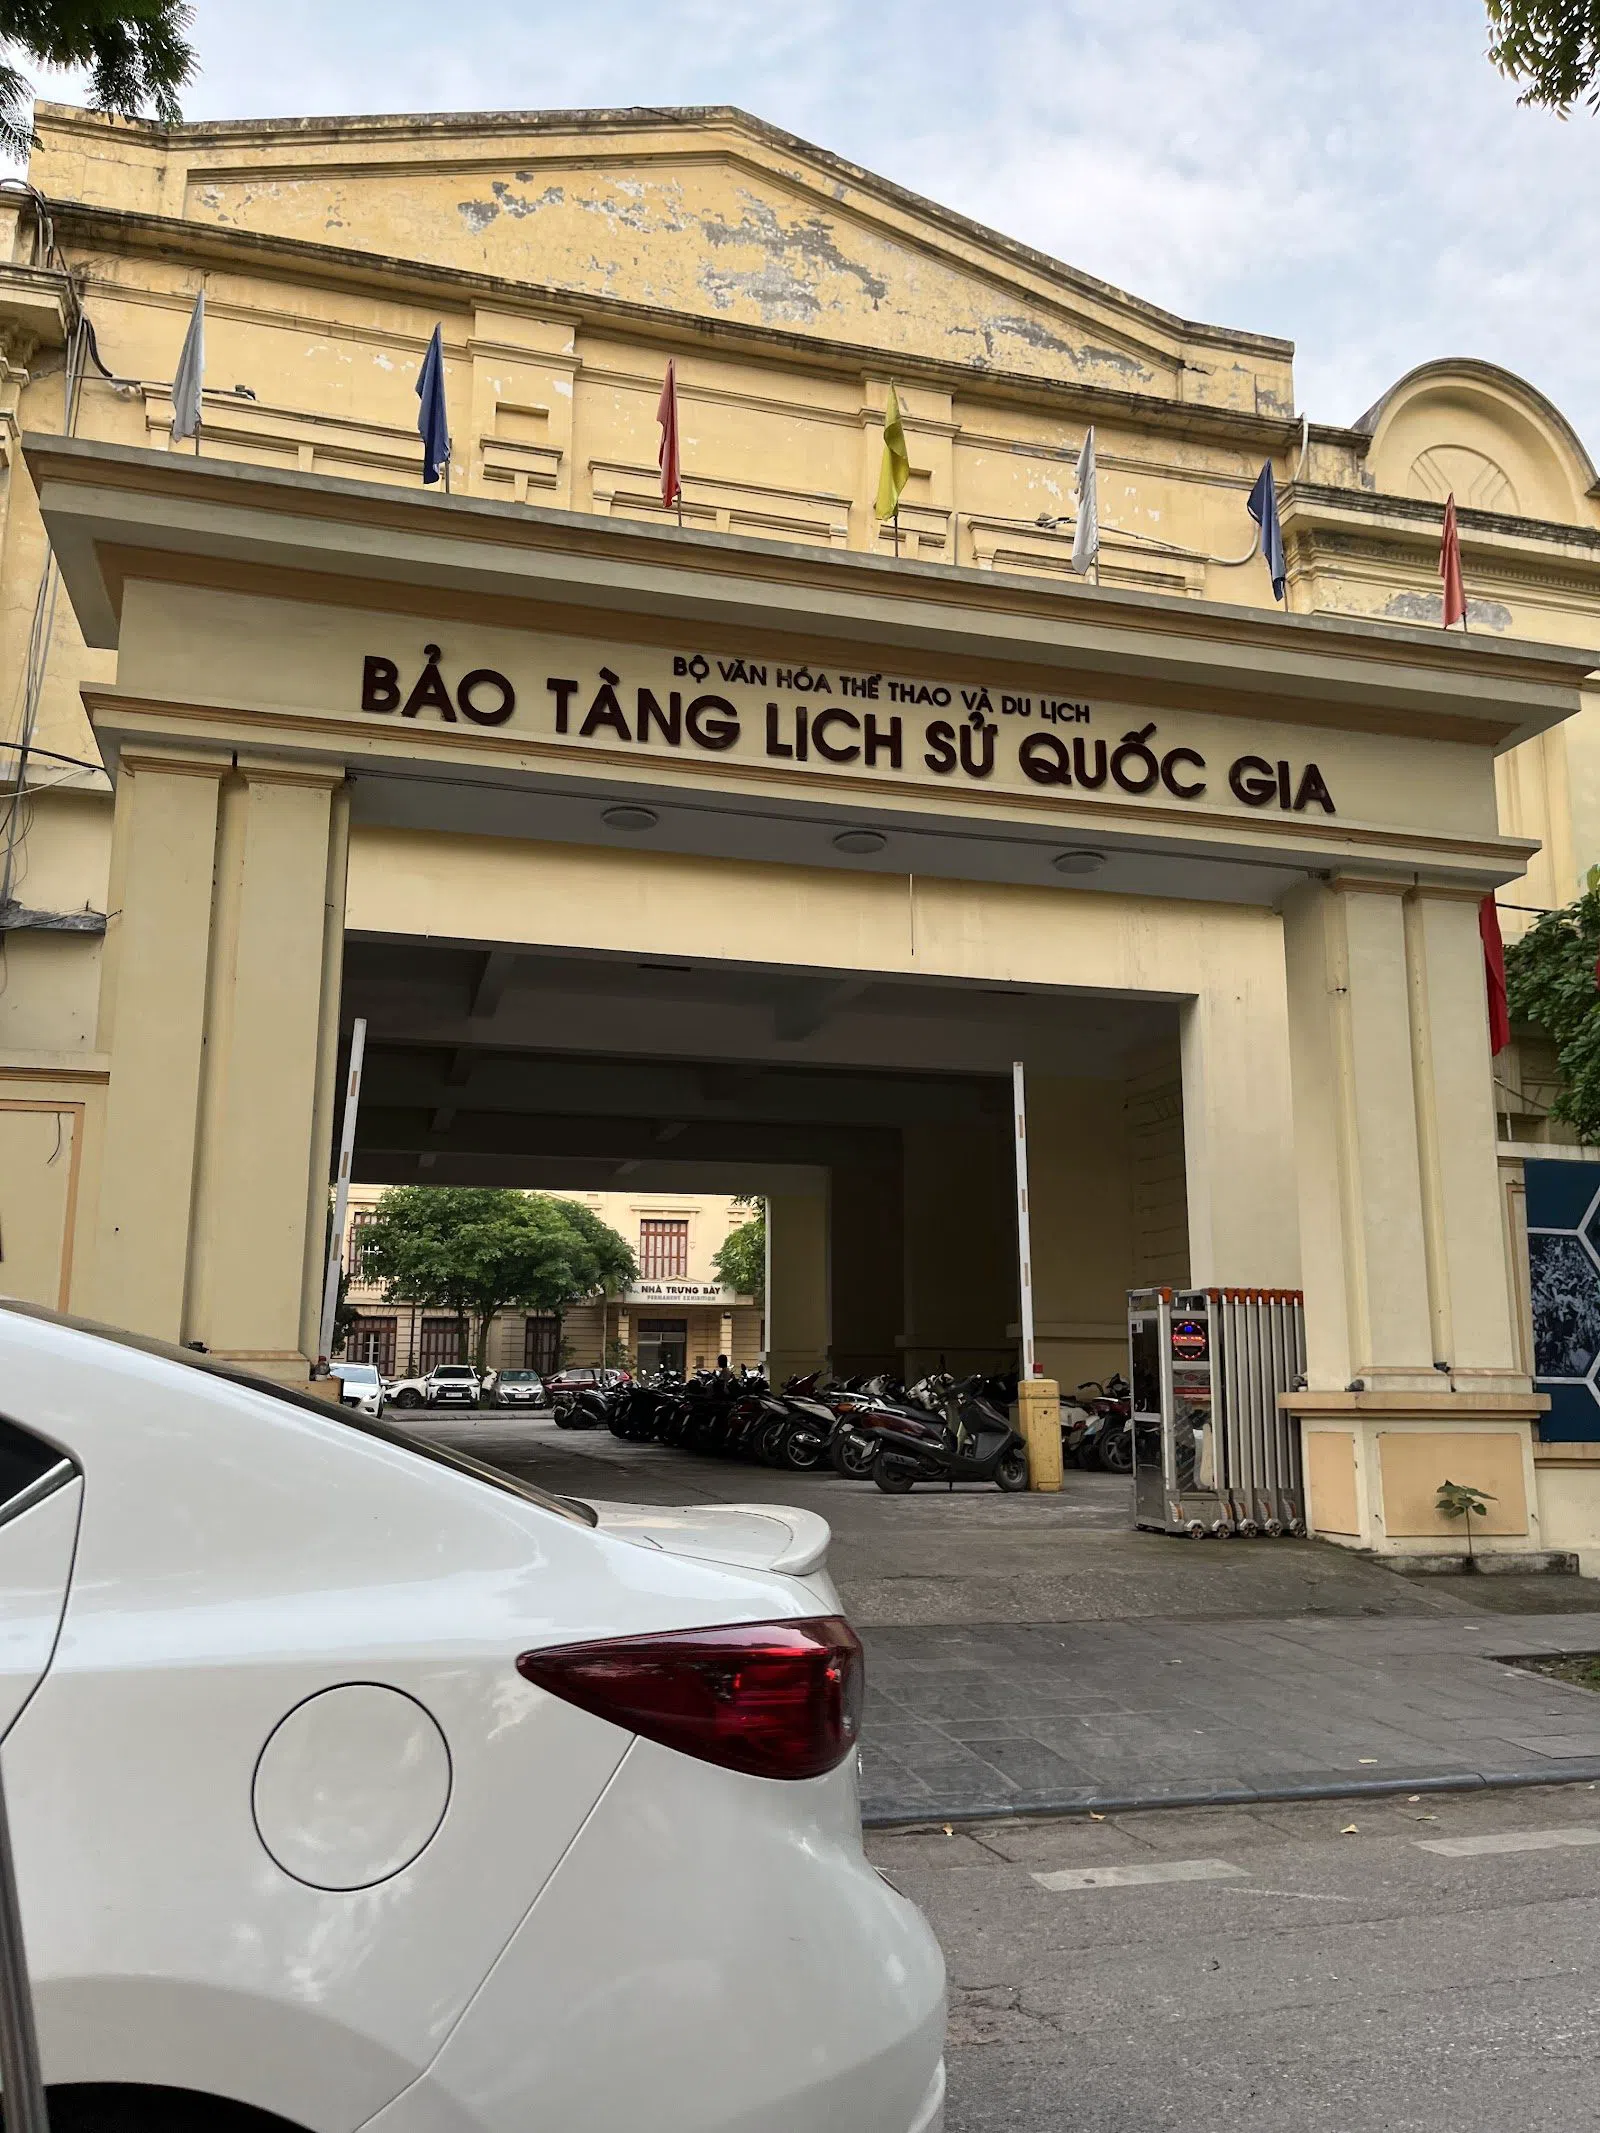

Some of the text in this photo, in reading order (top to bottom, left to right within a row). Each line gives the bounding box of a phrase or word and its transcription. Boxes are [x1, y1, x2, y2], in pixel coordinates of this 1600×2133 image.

[673, 654, 1090, 725] BỘ VĂN HÓA THỂ THAO VÀ DU LỊCH
[361, 644, 515, 727] BẢO
[546, 667, 741, 752] TÀNG
[924, 711, 998, 778] SỬ
[1018, 722, 1207, 800] QUỐC
[1228, 755, 1337, 814] GIA
[641, 1285, 662, 1294] NHÀ
[703, 1285, 721, 1295] BÀY
